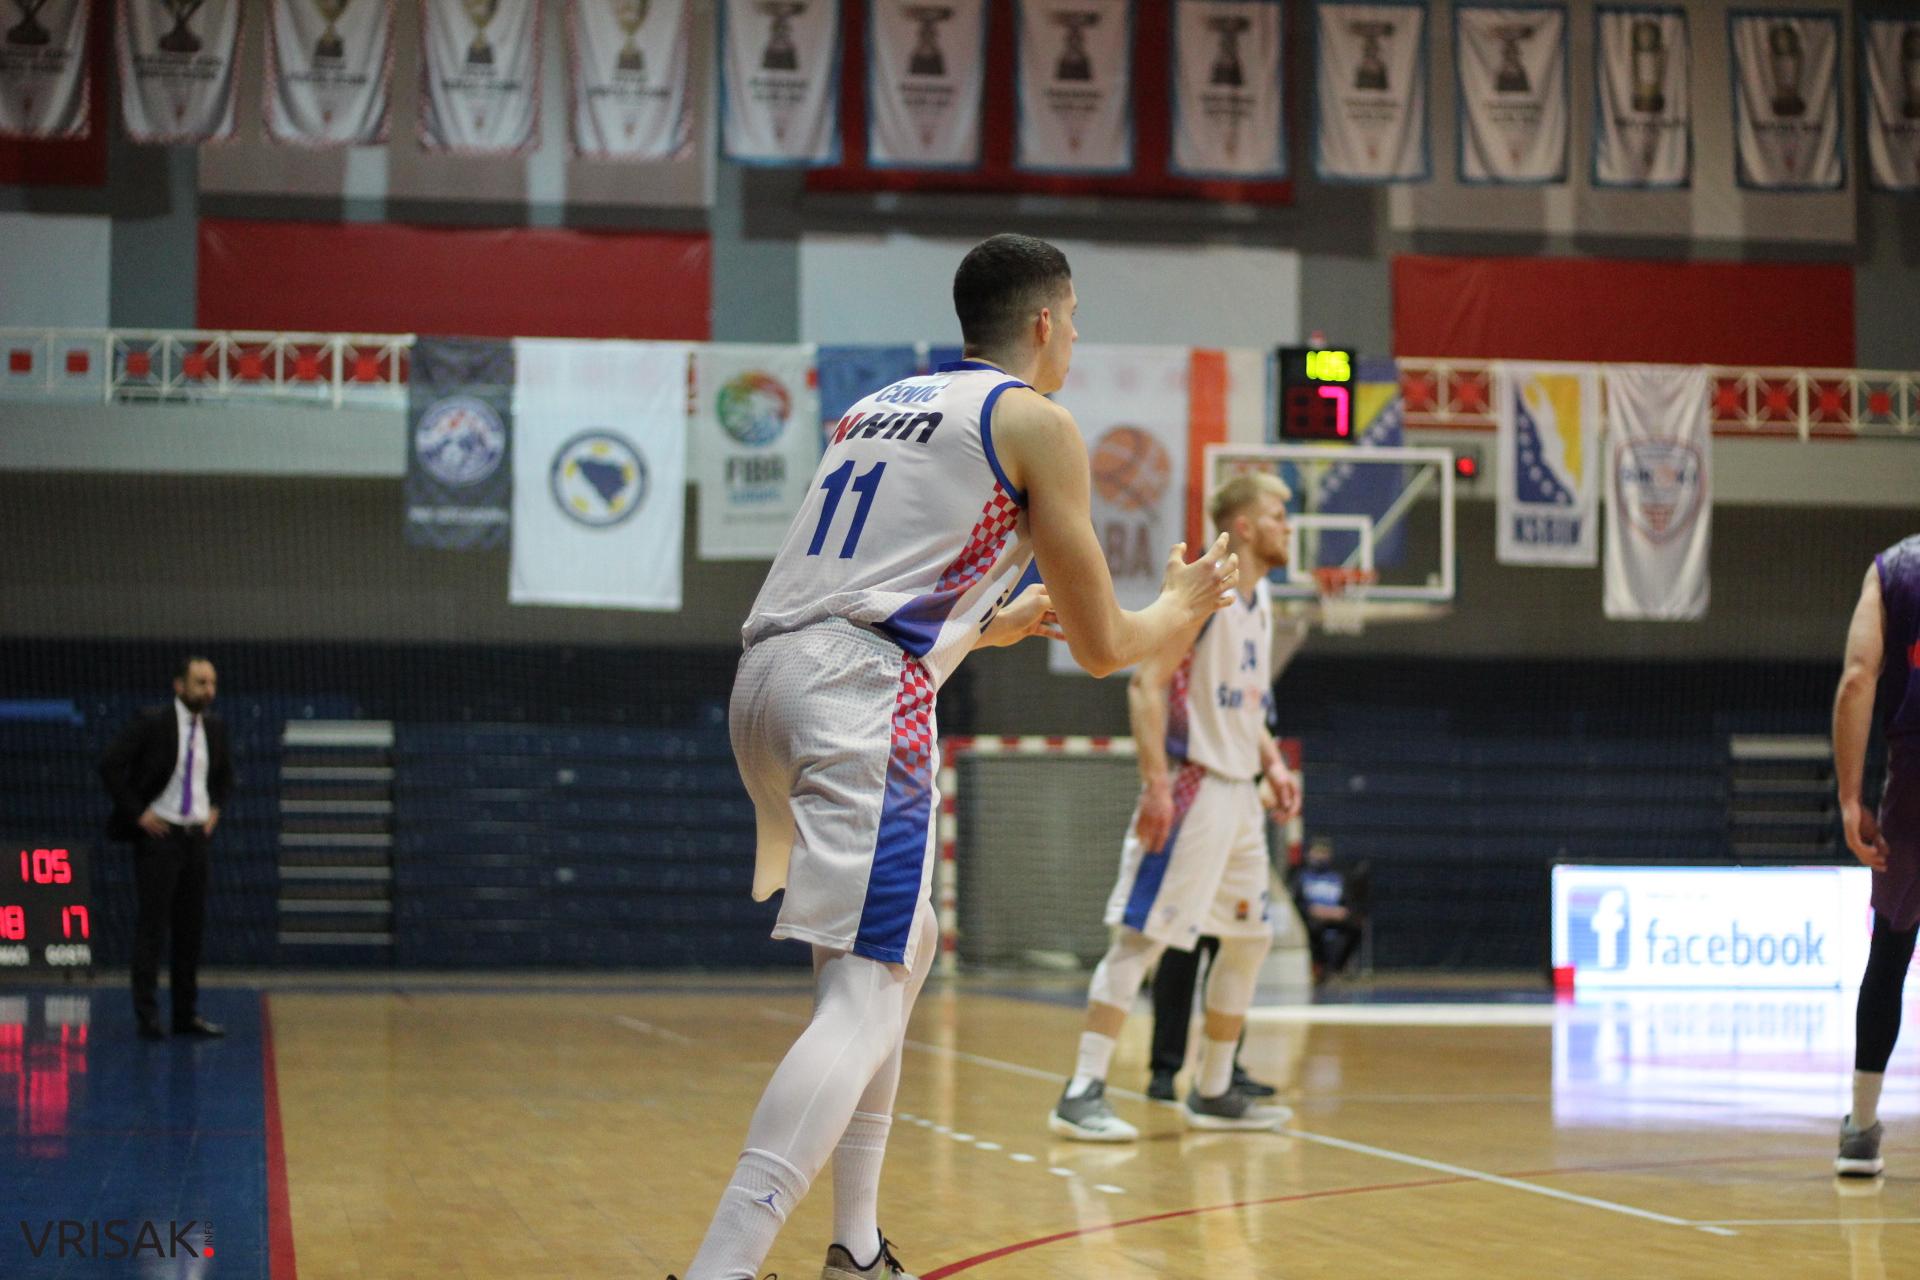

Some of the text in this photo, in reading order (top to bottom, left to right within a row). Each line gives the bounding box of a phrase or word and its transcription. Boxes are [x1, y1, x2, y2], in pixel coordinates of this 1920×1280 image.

[1317, 385, 1349, 437] 7
[806, 459, 887, 559] 11
[62, 904, 90, 940] 17
[1644, 918, 1826, 967] facebook
